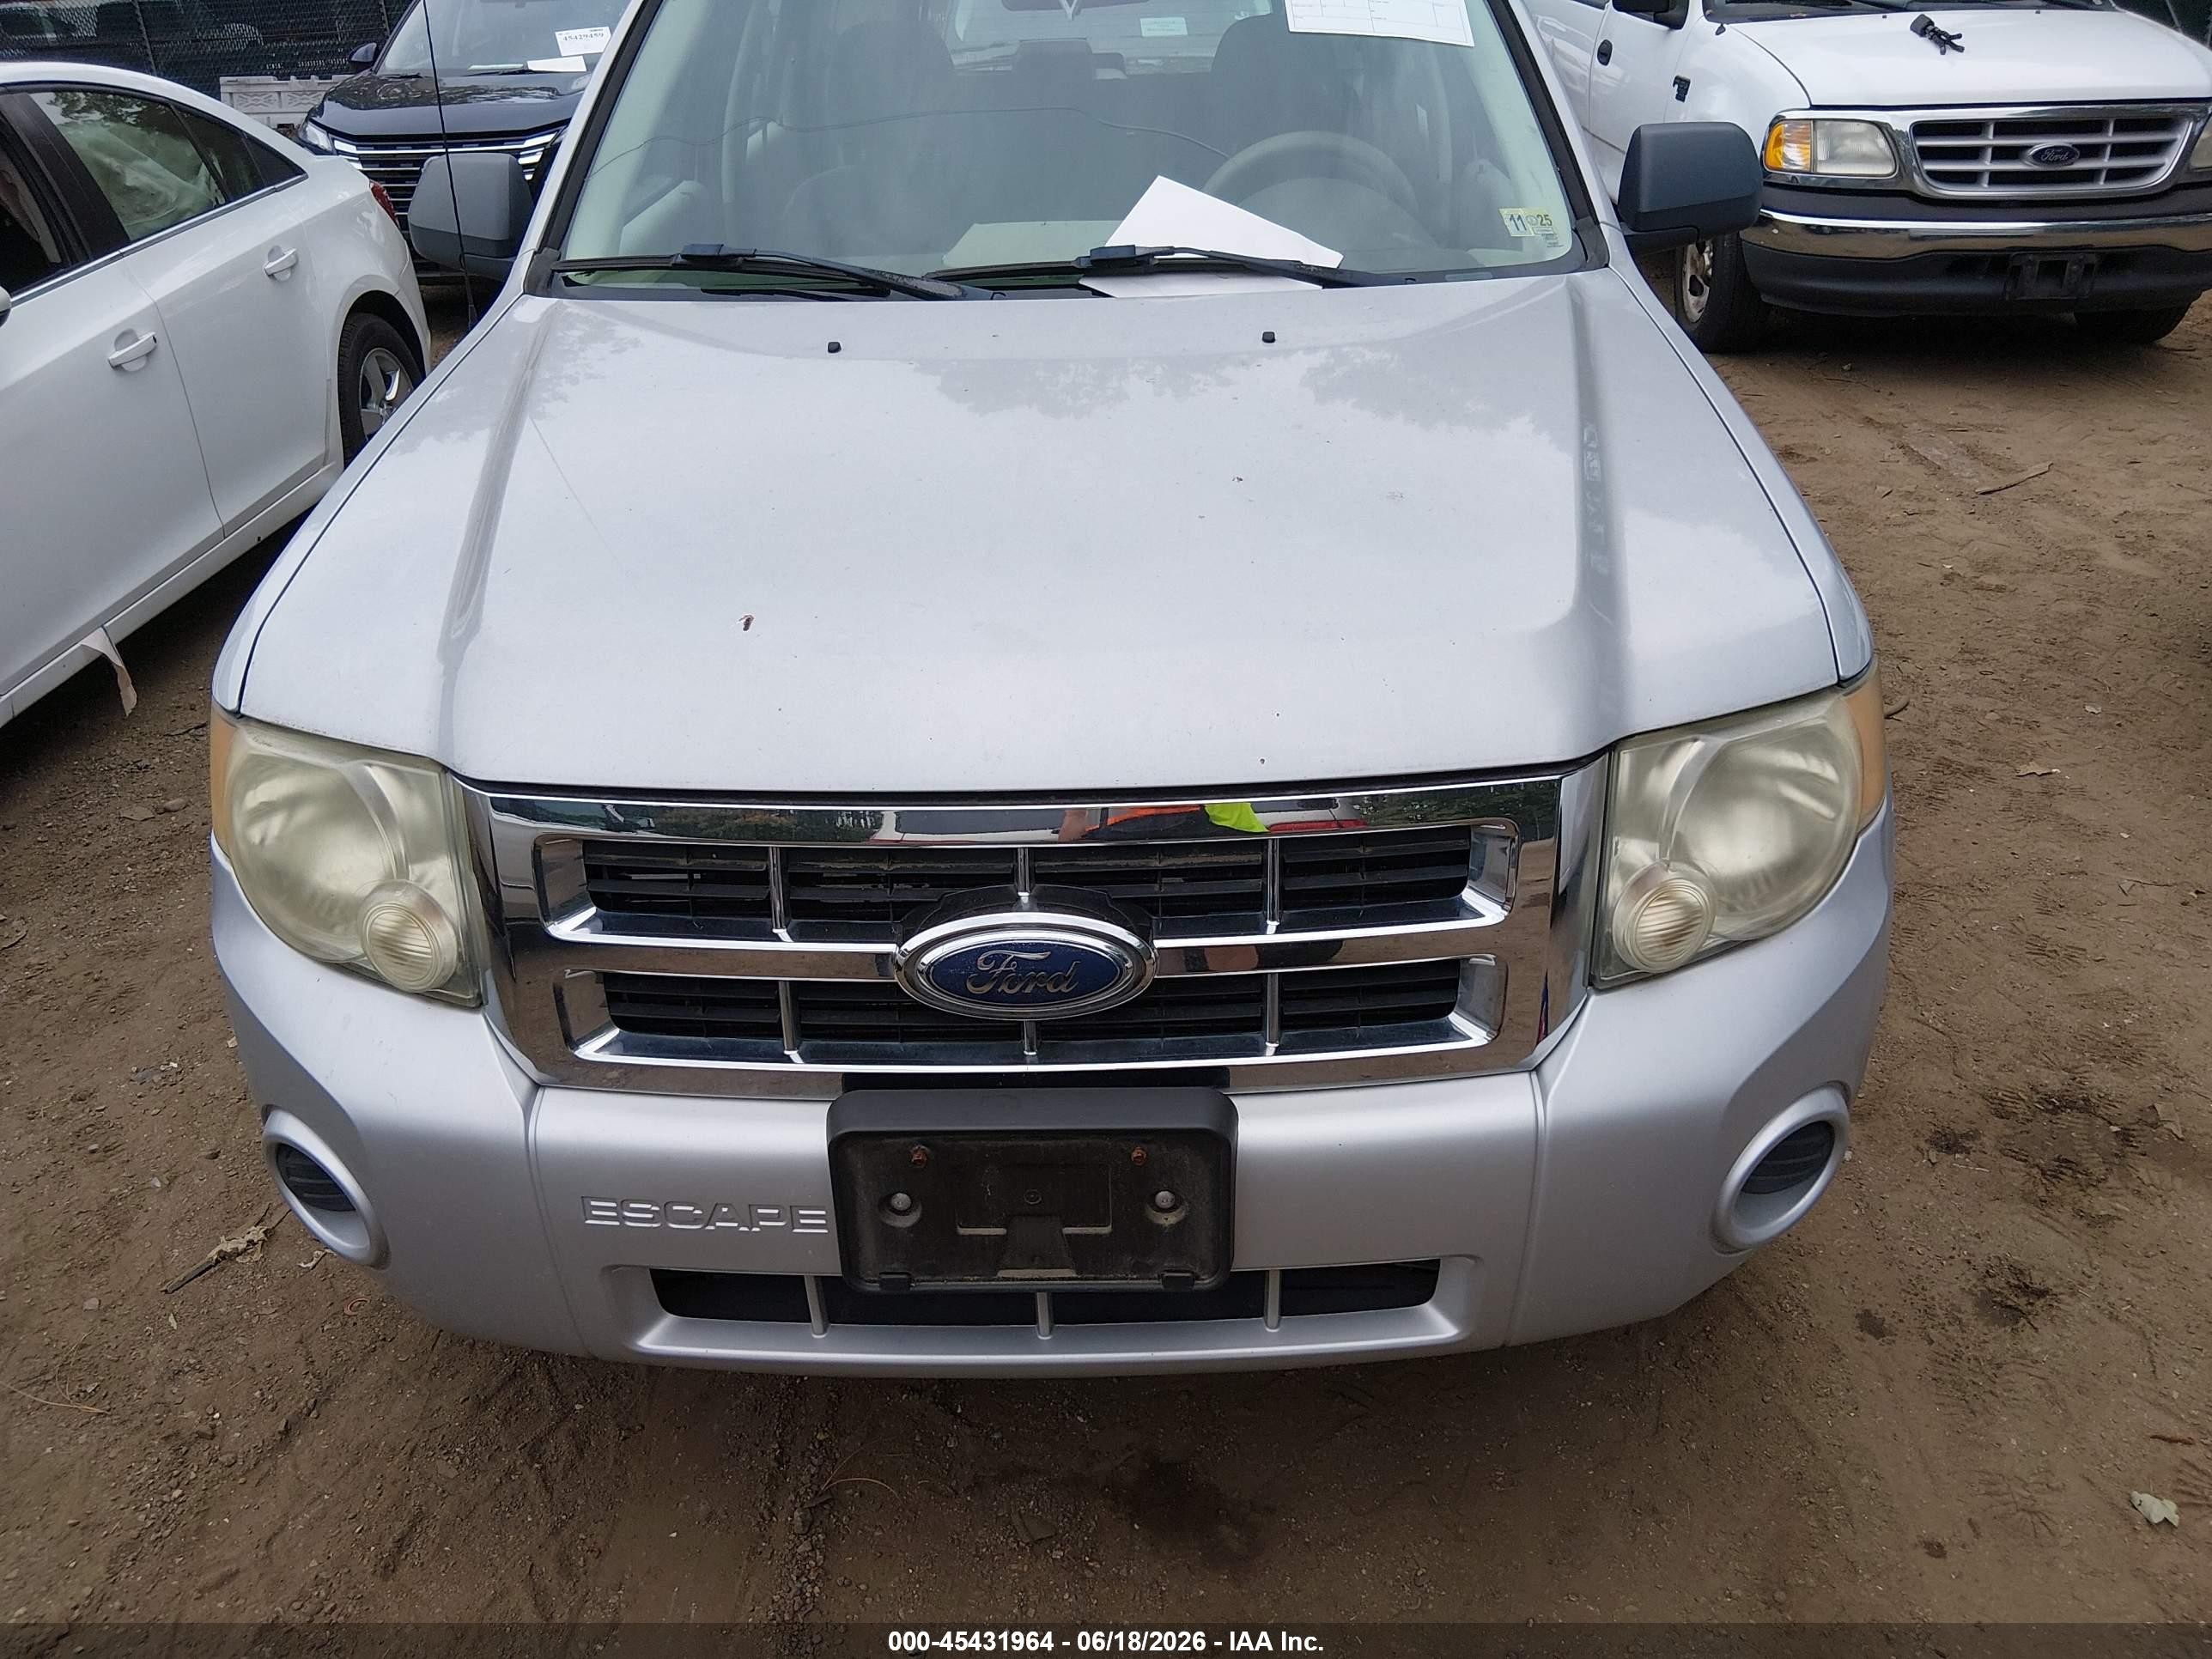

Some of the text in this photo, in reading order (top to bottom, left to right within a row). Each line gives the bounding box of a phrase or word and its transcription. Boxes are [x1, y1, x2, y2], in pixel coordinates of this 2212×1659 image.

[2040, 149, 2069, 162] Ford
[1510, 213, 1553, 232] 11 25
[966, 949, 1082, 995] Ford
[580, 1196, 830, 1234] ESCAPE
